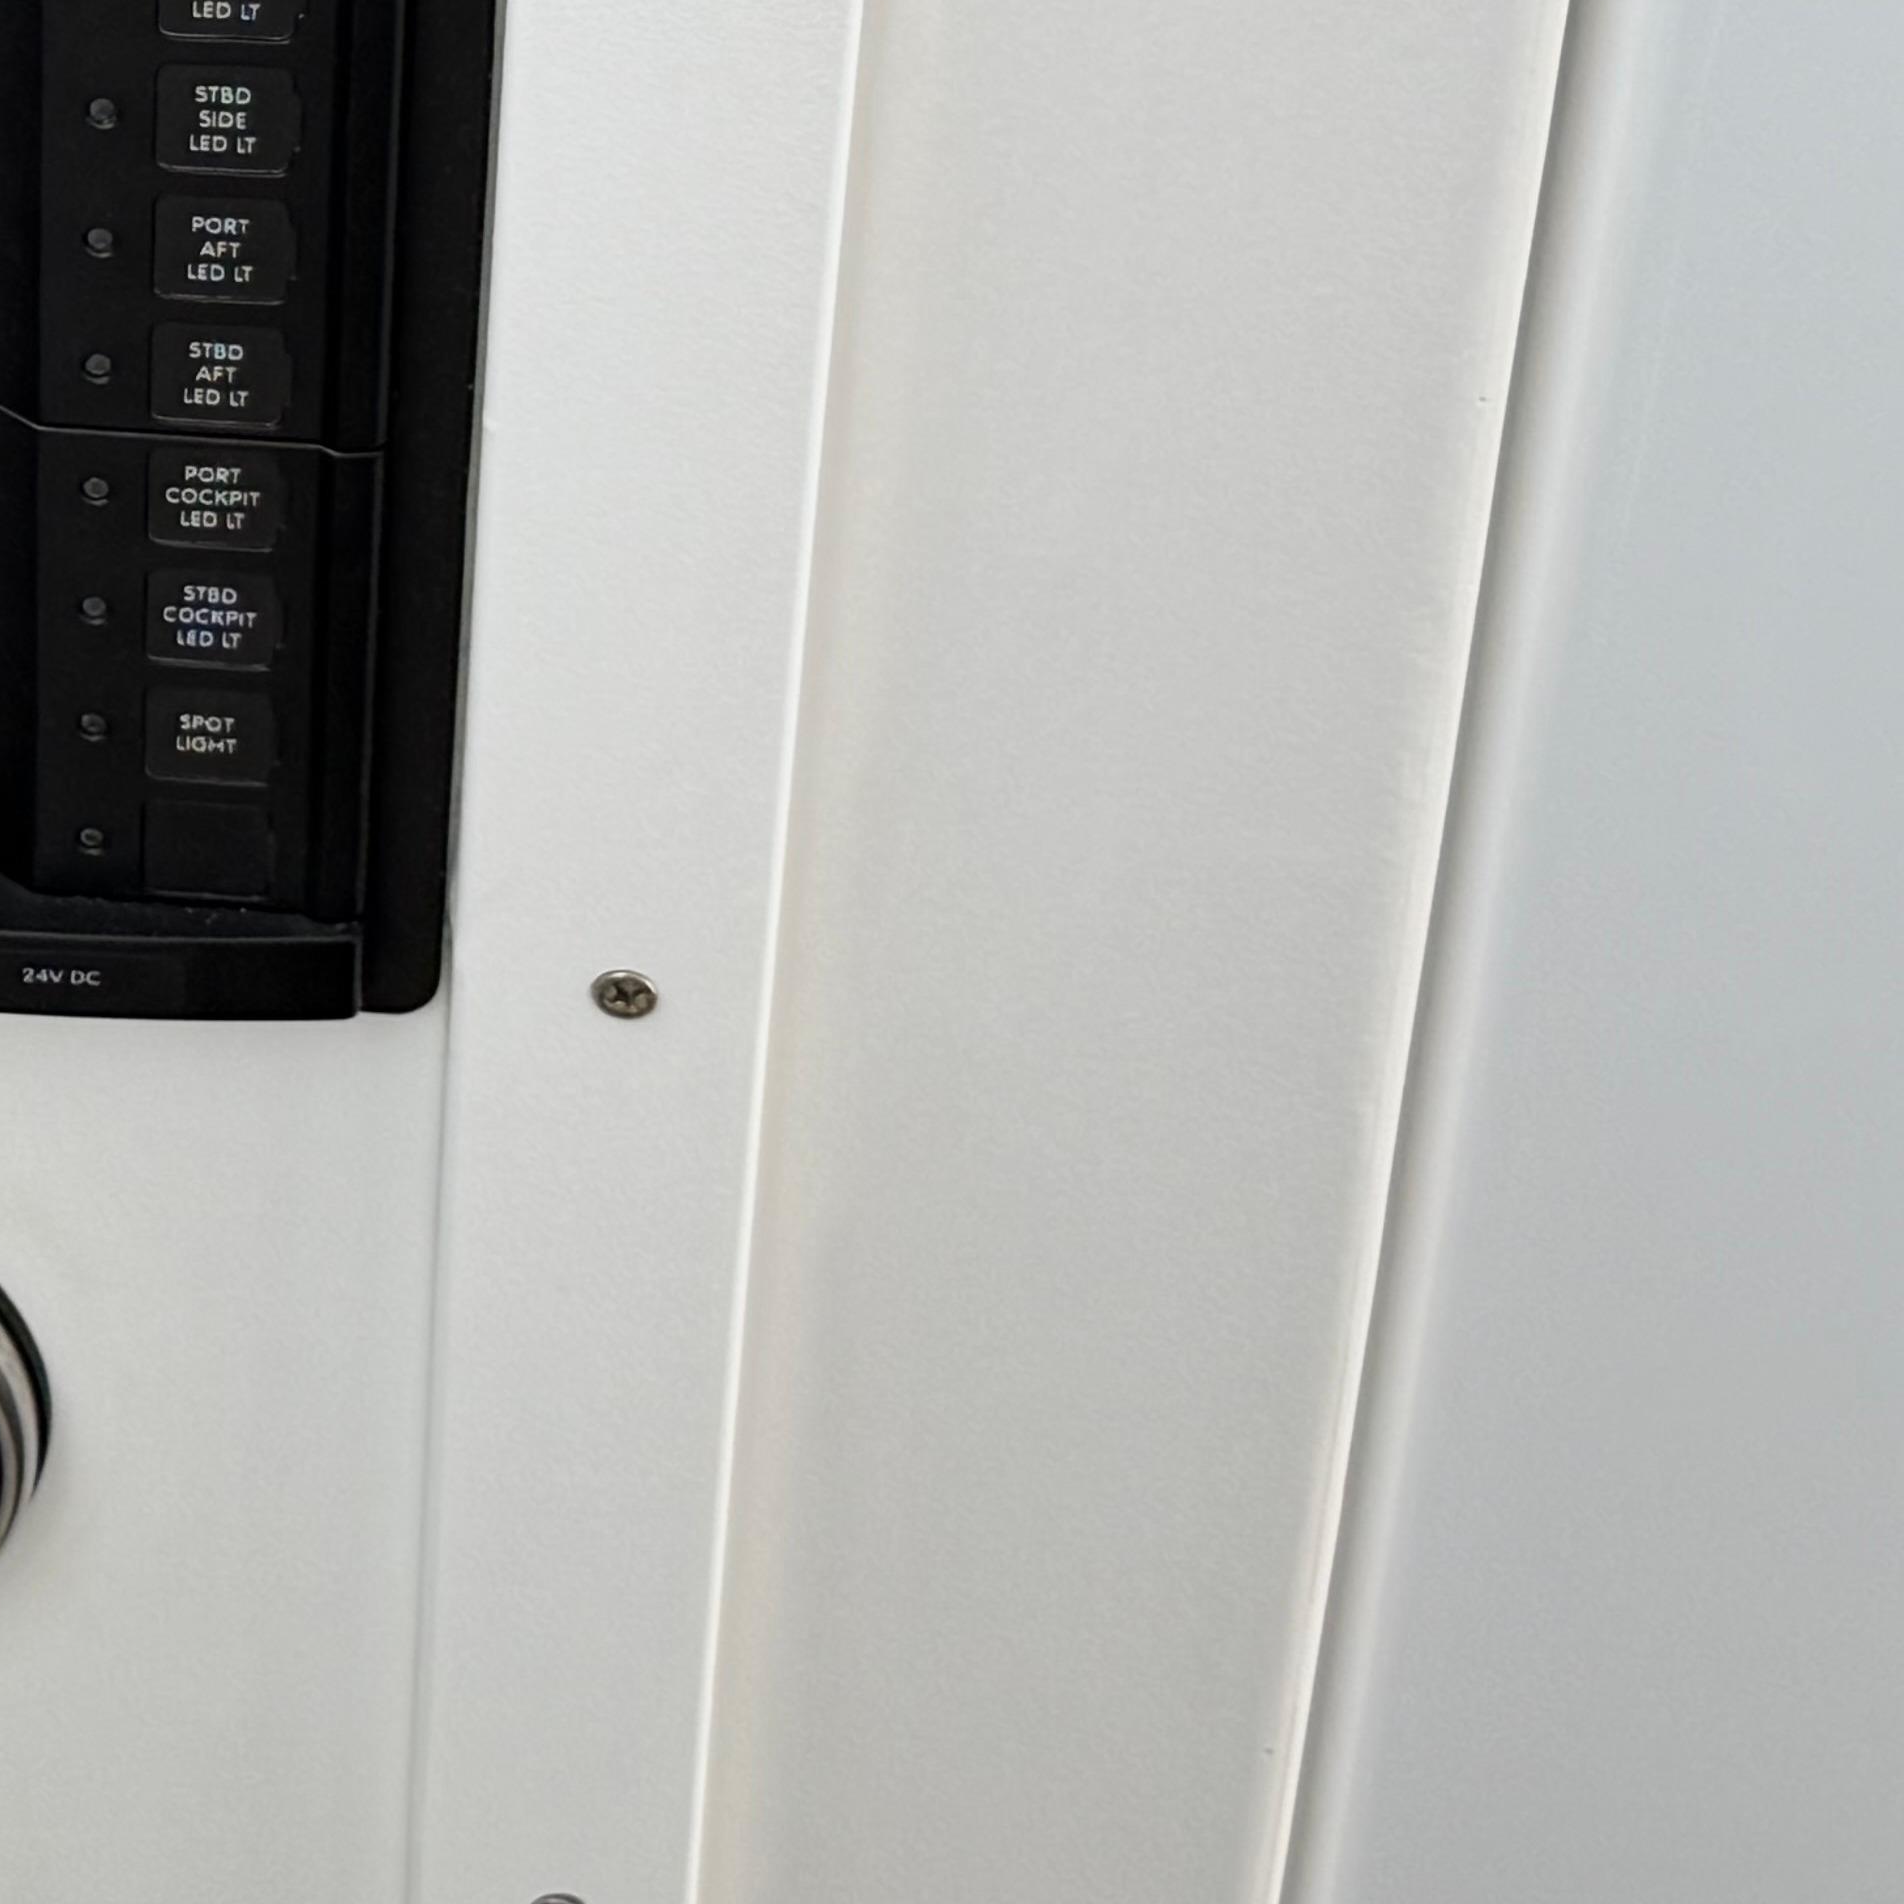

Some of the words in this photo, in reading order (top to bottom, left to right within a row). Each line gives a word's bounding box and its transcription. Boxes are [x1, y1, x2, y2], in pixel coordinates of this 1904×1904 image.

[193, 1, 231, 19] LED
[241, 4, 260, 20] LT
[195, 86, 251, 104] STBD
[200, 110, 246, 129] SIDE
[190, 135, 227, 152] LED
[237, 137, 256, 154] LT
[192, 216, 249, 235] PORT
[200, 241, 240, 258] AFT
[188, 264, 225, 281] LED
[234, 266, 253, 282] LT
[190, 342, 243, 360] STBD
[196, 366, 236, 383] AFT
[184, 388, 220, 405] LED
[230, 391, 248, 407] LT
[185, 466, 241, 483] PORT
[166, 488, 260, 506] COCKPIT
[181, 511, 217, 527] LED
[227, 512, 245, 529] LT
[184, 586, 237, 604] STBD
[164, 606, 256, 627] COCKPIT
[177, 629, 213, 647] LED
[222, 632, 241, 648] LT
[180, 714, 234, 732] SPOT
[177, 736, 236, 753] LIGHT
[23, 968, 63, 983] 24V
[71, 970, 100, 986] DC
